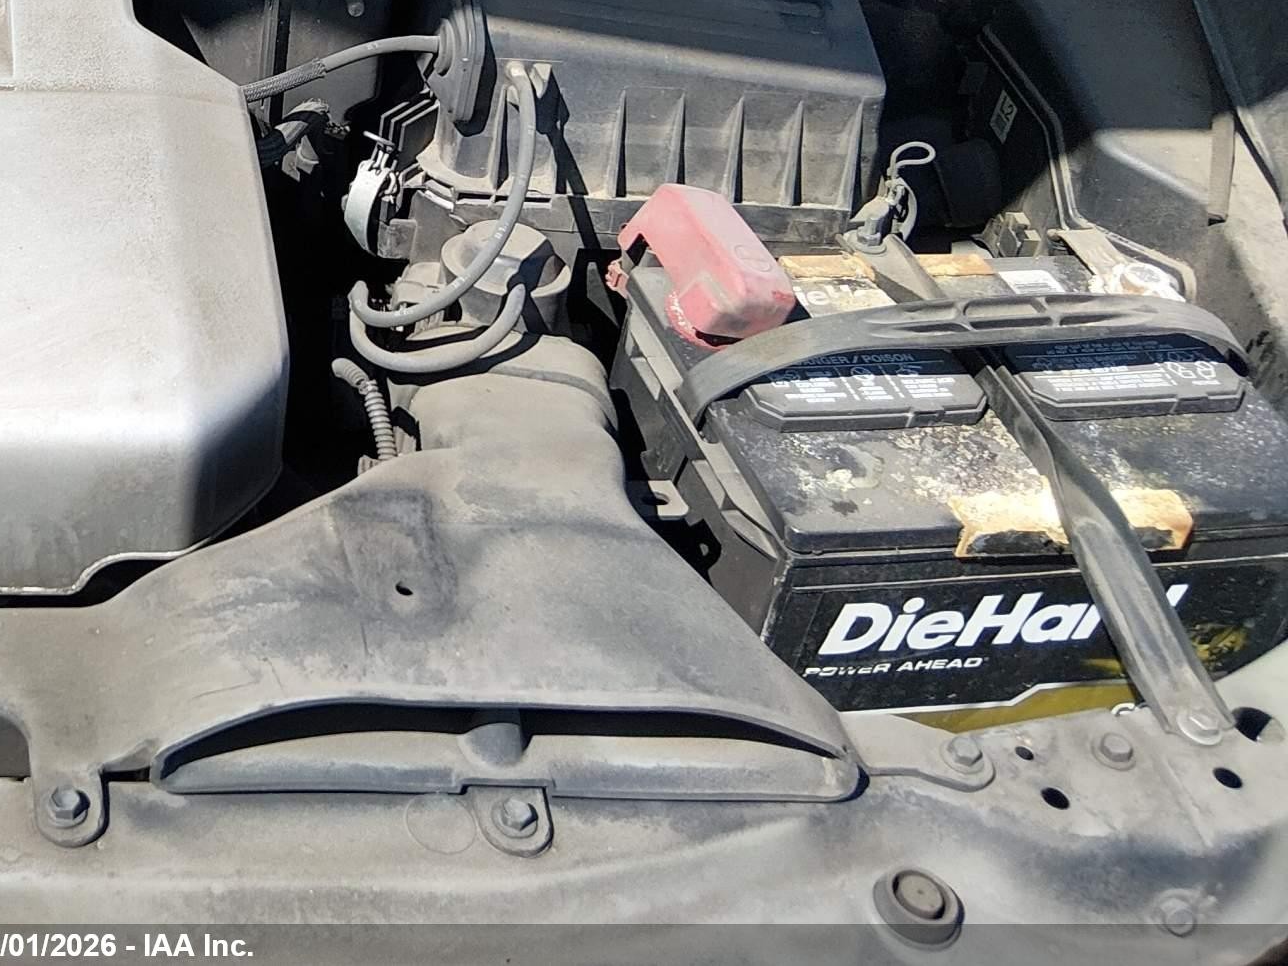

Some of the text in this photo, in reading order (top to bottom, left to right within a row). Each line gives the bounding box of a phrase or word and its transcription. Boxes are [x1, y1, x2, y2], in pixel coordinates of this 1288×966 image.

[862, 353, 915, 363] POISON
[818, 583, 1189, 656] DieHar
[896, 657, 984, 673] AHEAD
